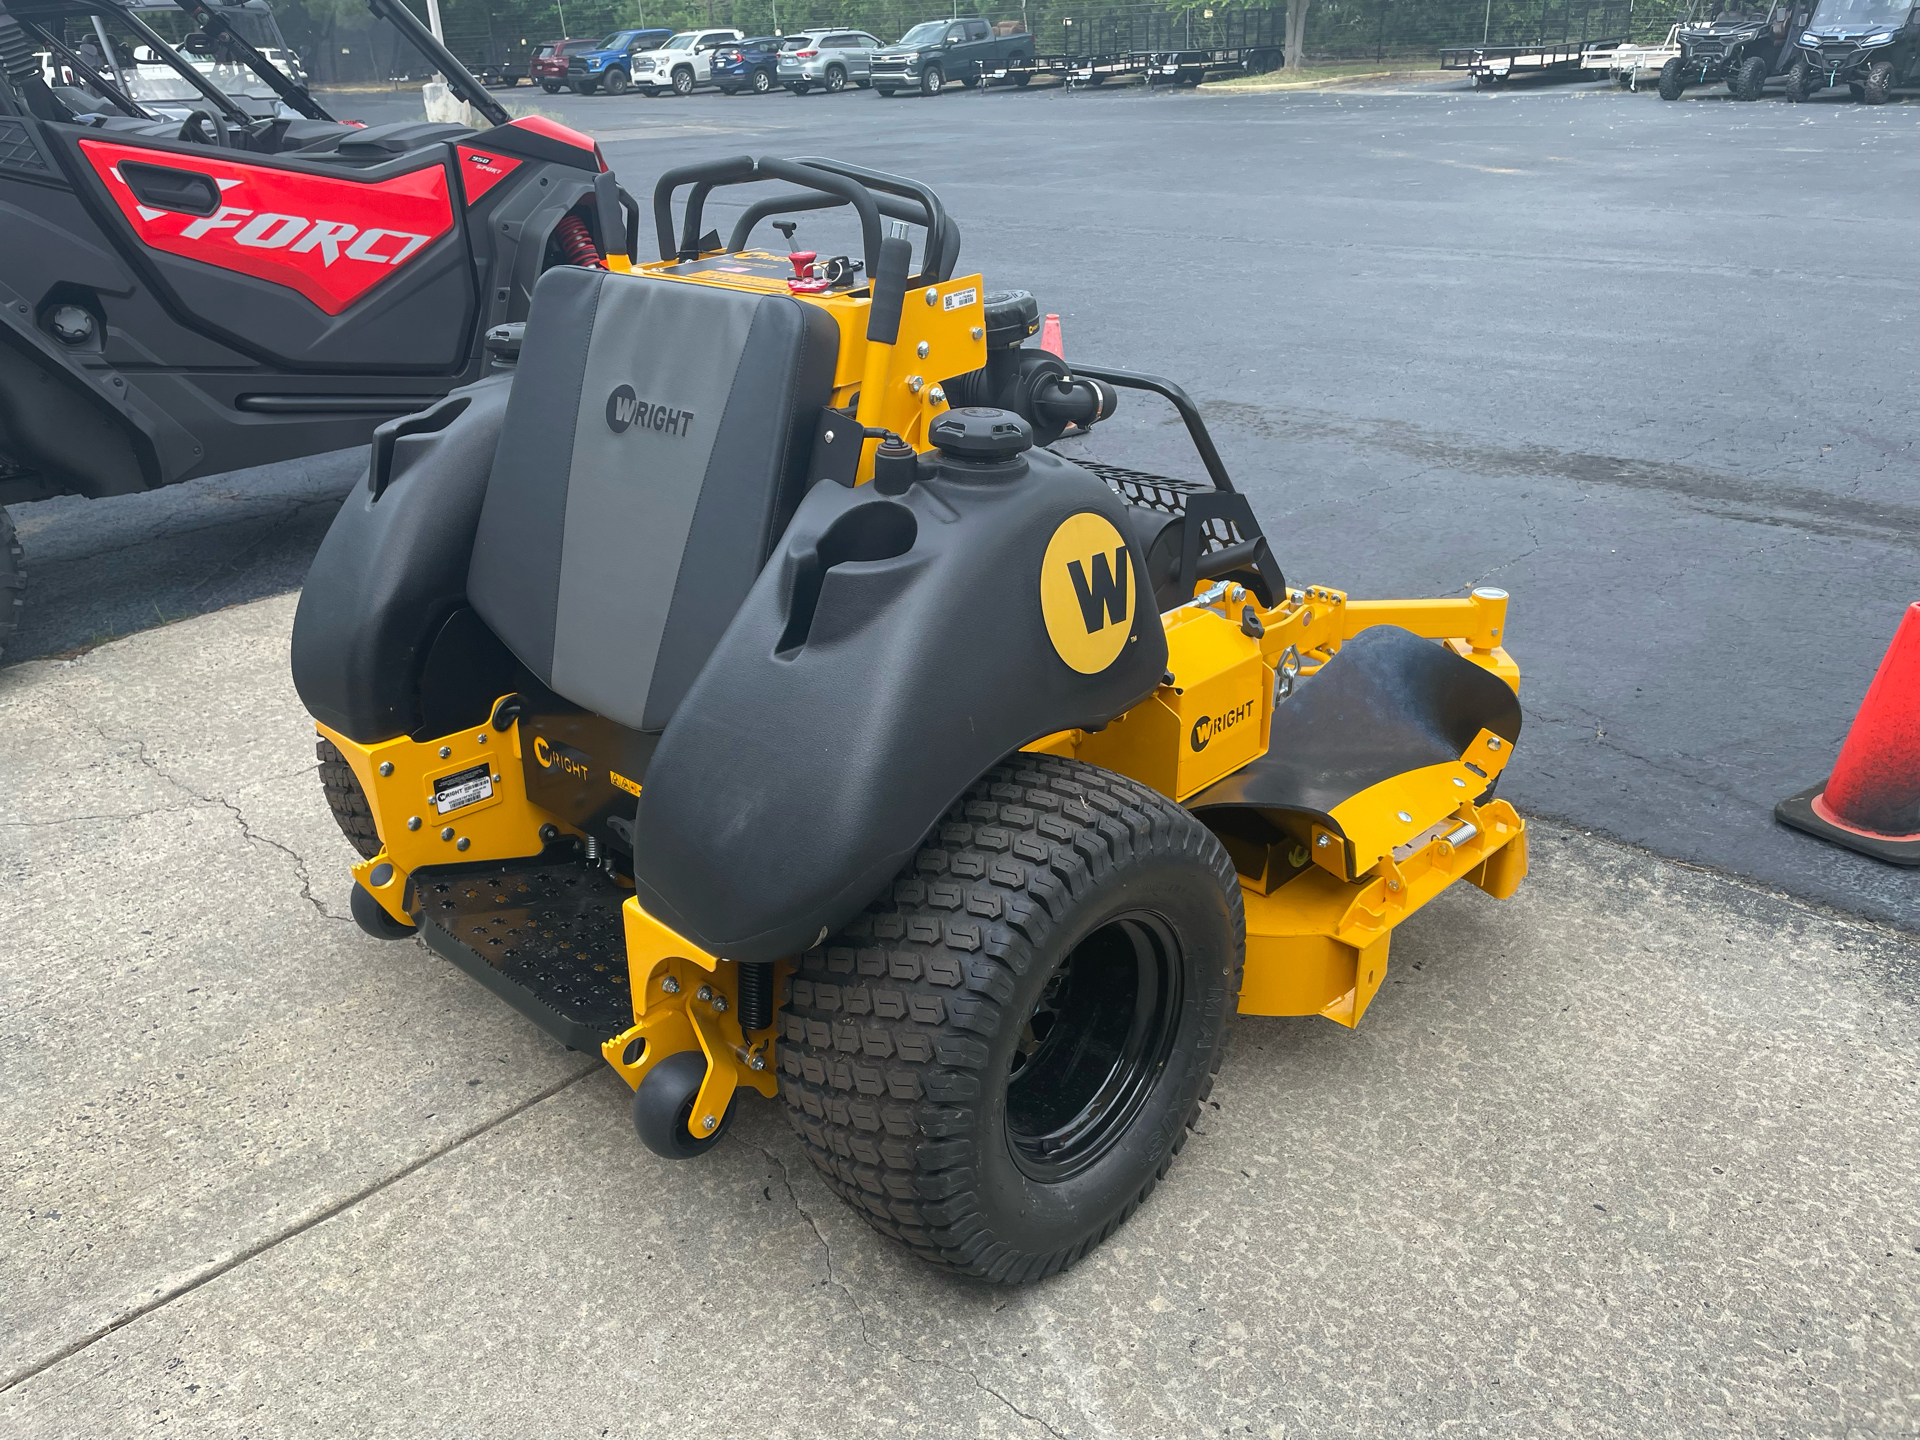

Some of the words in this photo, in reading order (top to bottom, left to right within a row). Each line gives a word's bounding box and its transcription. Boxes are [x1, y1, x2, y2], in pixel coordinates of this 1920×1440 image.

[471, 155, 490, 164] 950
[475, 164, 502, 174] SPORT
[606, 384, 695, 438] WRIGHT
[1066, 545, 1128, 635] W
[1190, 699, 1254, 752] WRIGHT
[534, 736, 588, 781] WRIGHT
[437, 787, 463, 802] WRIGHT
